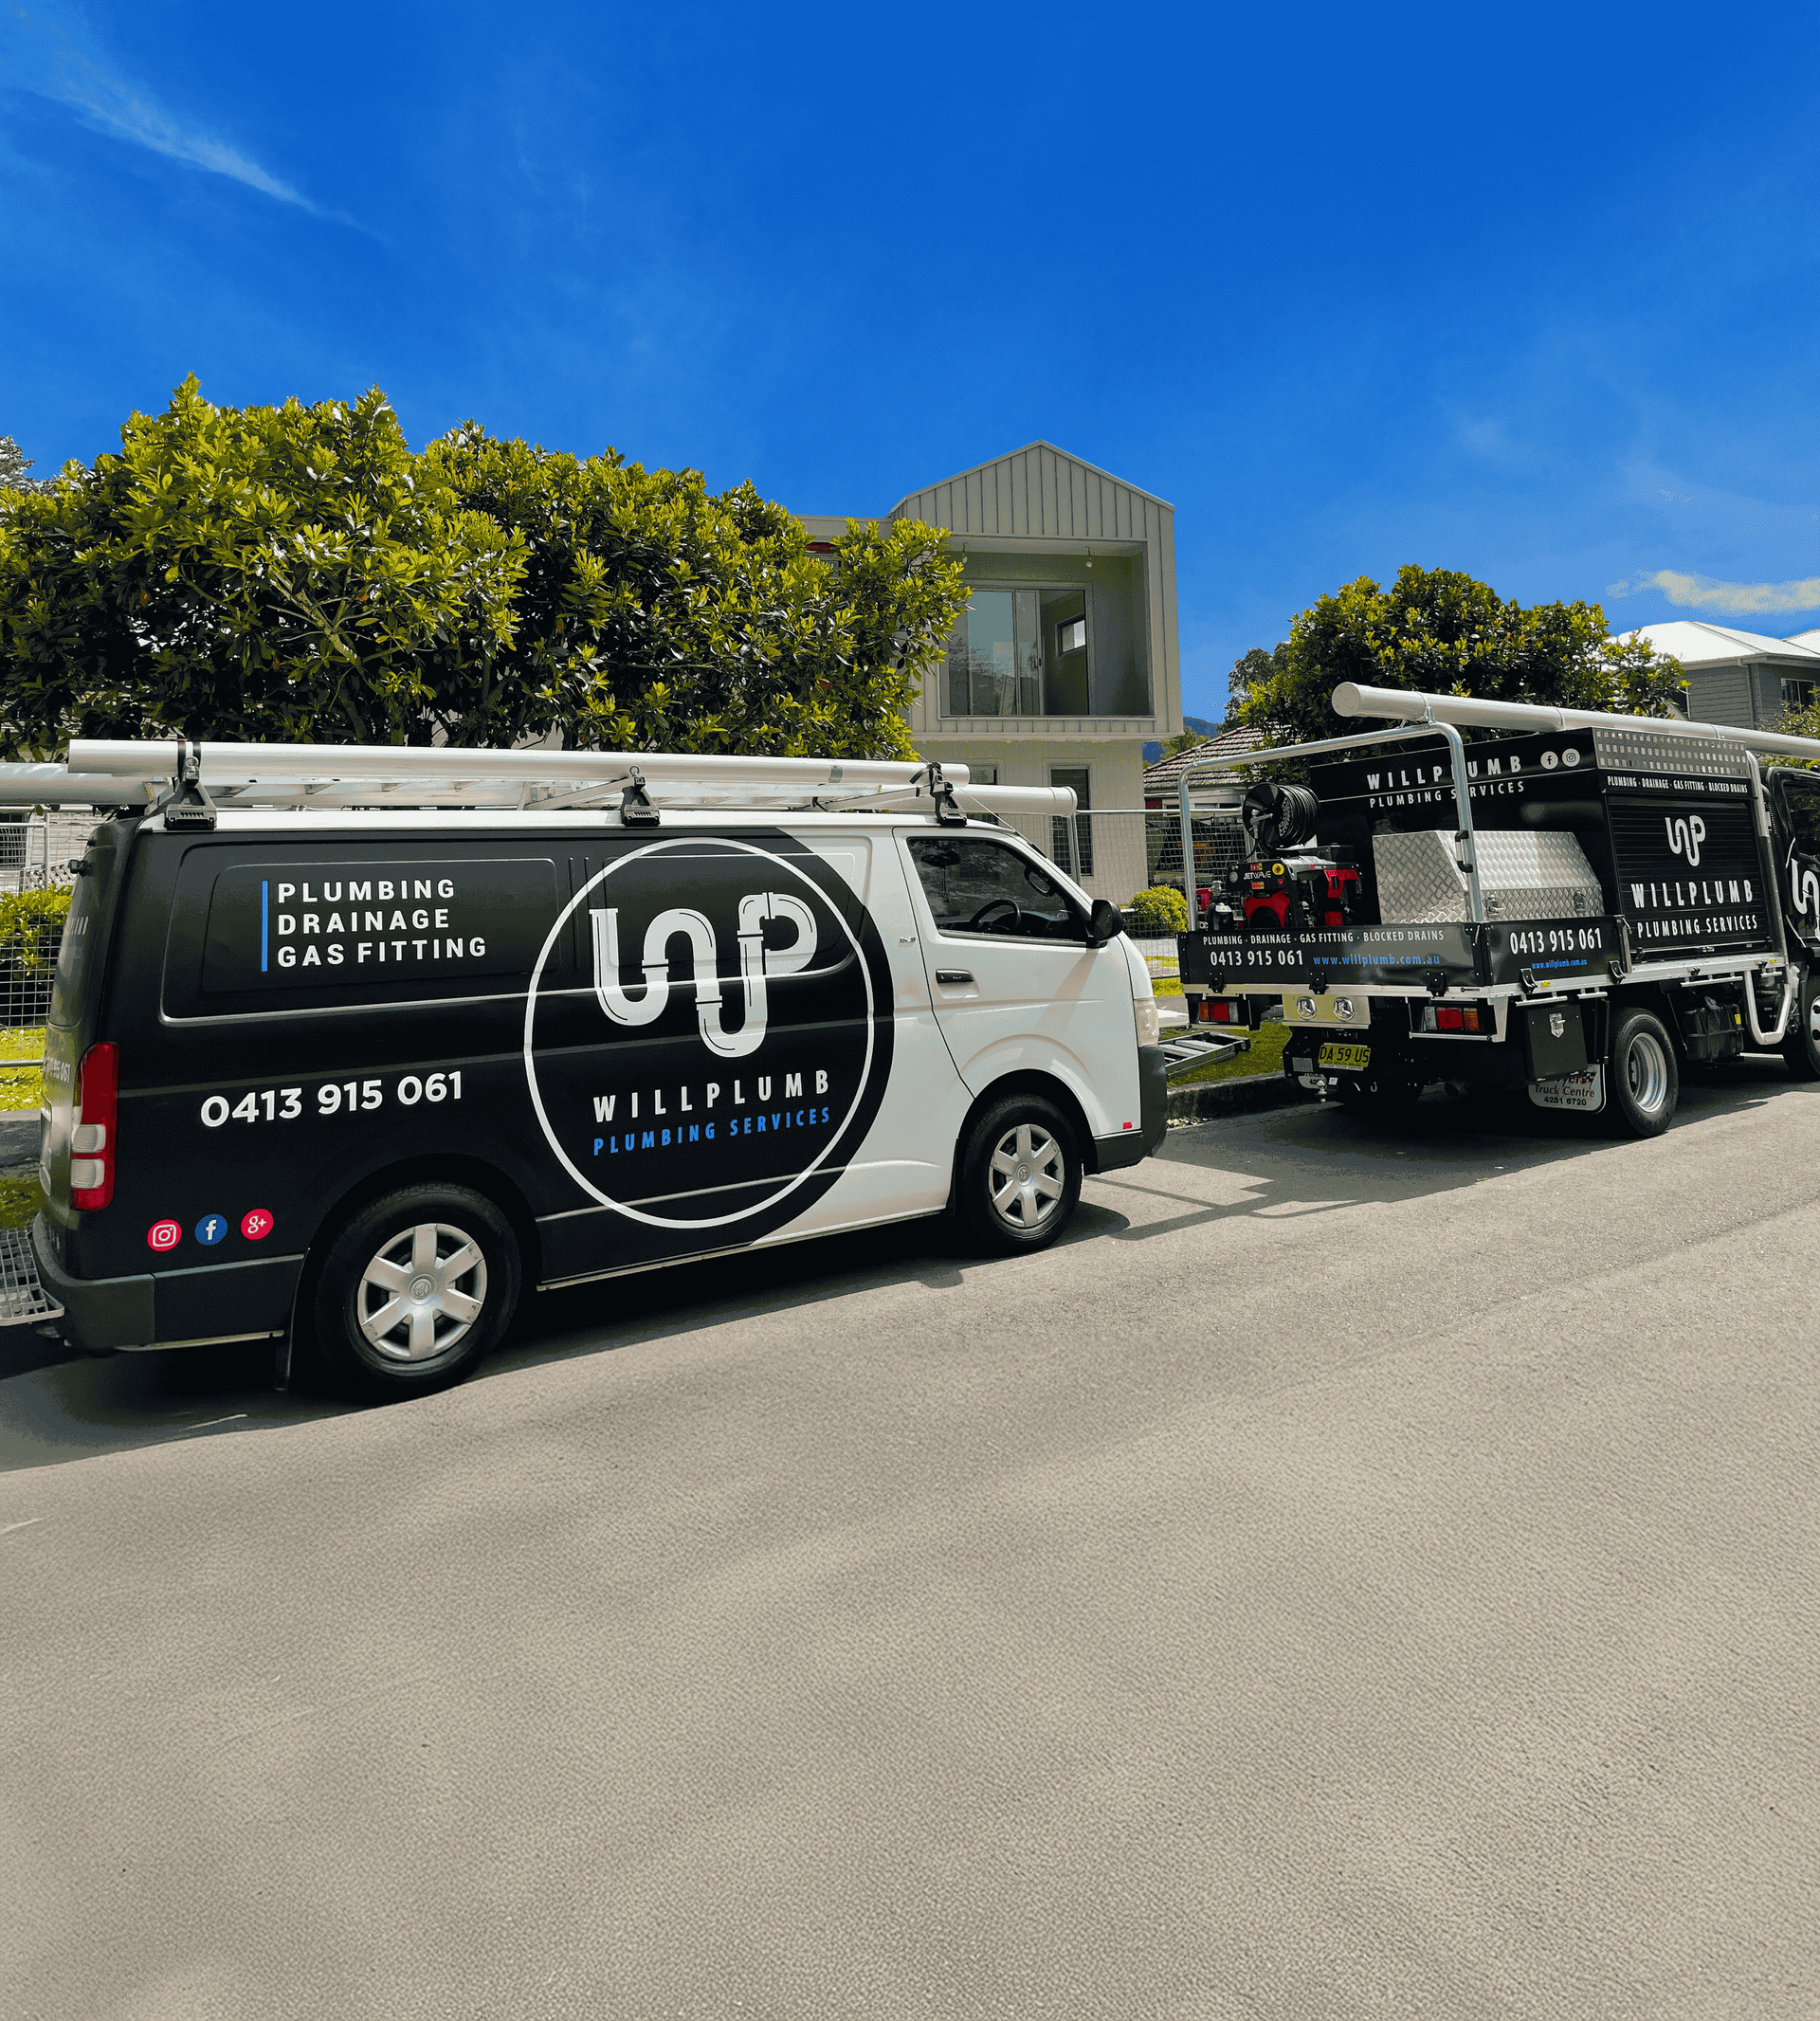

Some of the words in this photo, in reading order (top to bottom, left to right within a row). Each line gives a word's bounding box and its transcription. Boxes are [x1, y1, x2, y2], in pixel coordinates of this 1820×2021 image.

[1370, 791, 1442, 808] PLUMBING
[1451, 781, 1524, 800] SRVICES
[1607, 775, 1637, 788] PLUMBING
[1641, 777, 1669, 790] DRAINAGE
[1673, 779, 1684, 791] GAS
[1684, 780, 1705, 792] FITTING
[1708, 781, 1730, 792] BLOCKED
[1730, 783, 1748, 793] DRAINS
[1244, 871, 1271, 880] JETWAVE
[278, 879, 456, 903] PLUMBING
[1630, 879, 1754, 909] WILLPLUMB
[278, 909, 449, 936] DRAINAGE
[1637, 918, 1701, 938] PLUMBING
[1705, 914, 1758, 934] SERVICES
[1203, 935, 1243, 946] PLUMBING
[1250, 933, 1292, 945] DRAINAGE
[1300, 932, 1317, 943] GAS
[1318, 931, 1355, 943] FITTING
[1363, 930, 1405, 942] BLOCKED
[1408, 929, 1445, 941] DRAINS
[1509, 931, 1545, 955] 0413
[1549, 929, 1574, 952] 915
[1577, 927, 1602, 950] 061
[278, 940, 345, 968] GAS
[356, 937, 486, 964] FITTING
[1210, 950, 1243, 966] 0413
[1247, 950, 1273, 966] 915
[1278, 950, 1304, 965] 061
[1313, 953, 1440, 968] www.willplumb.com.au
[1319, 1047, 1334, 1061] DA
[1337, 1047, 1352, 1062] 59
[1354, 1048, 1370, 1063] US
[200, 1085, 302, 1127] 0413
[317, 1079, 383, 1116] 915
[397, 1071, 462, 1107] 061
[593, 1069, 829, 1123] WILLPLUMB
[1536, 1084, 1559, 1095] Truck
[1564, 1086, 1595, 1098] Centre
[1567, 1098, 1588, 1106] 6720
[593, 1123, 717, 1156] PLUMBING
[729, 1106, 830, 1136] SERVICES
